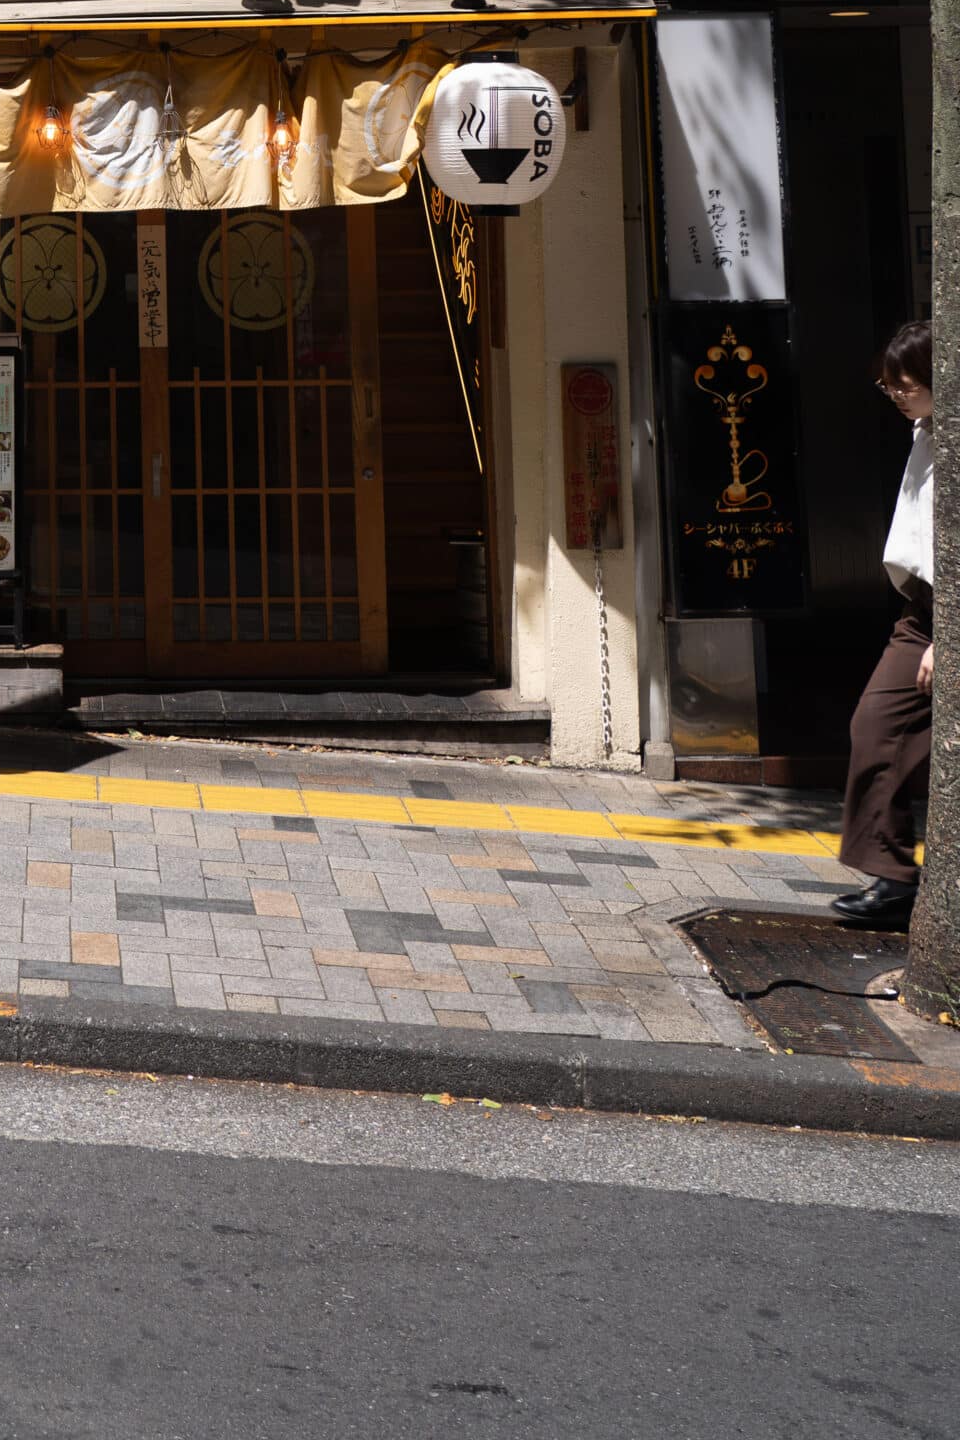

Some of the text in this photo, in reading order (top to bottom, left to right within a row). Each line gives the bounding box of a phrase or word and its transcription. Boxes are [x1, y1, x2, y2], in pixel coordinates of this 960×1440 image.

[529, 92, 553, 183] SOBA
[141, 240, 162, 346] 元気に営業中
[726, 558, 758, 580] 4F
